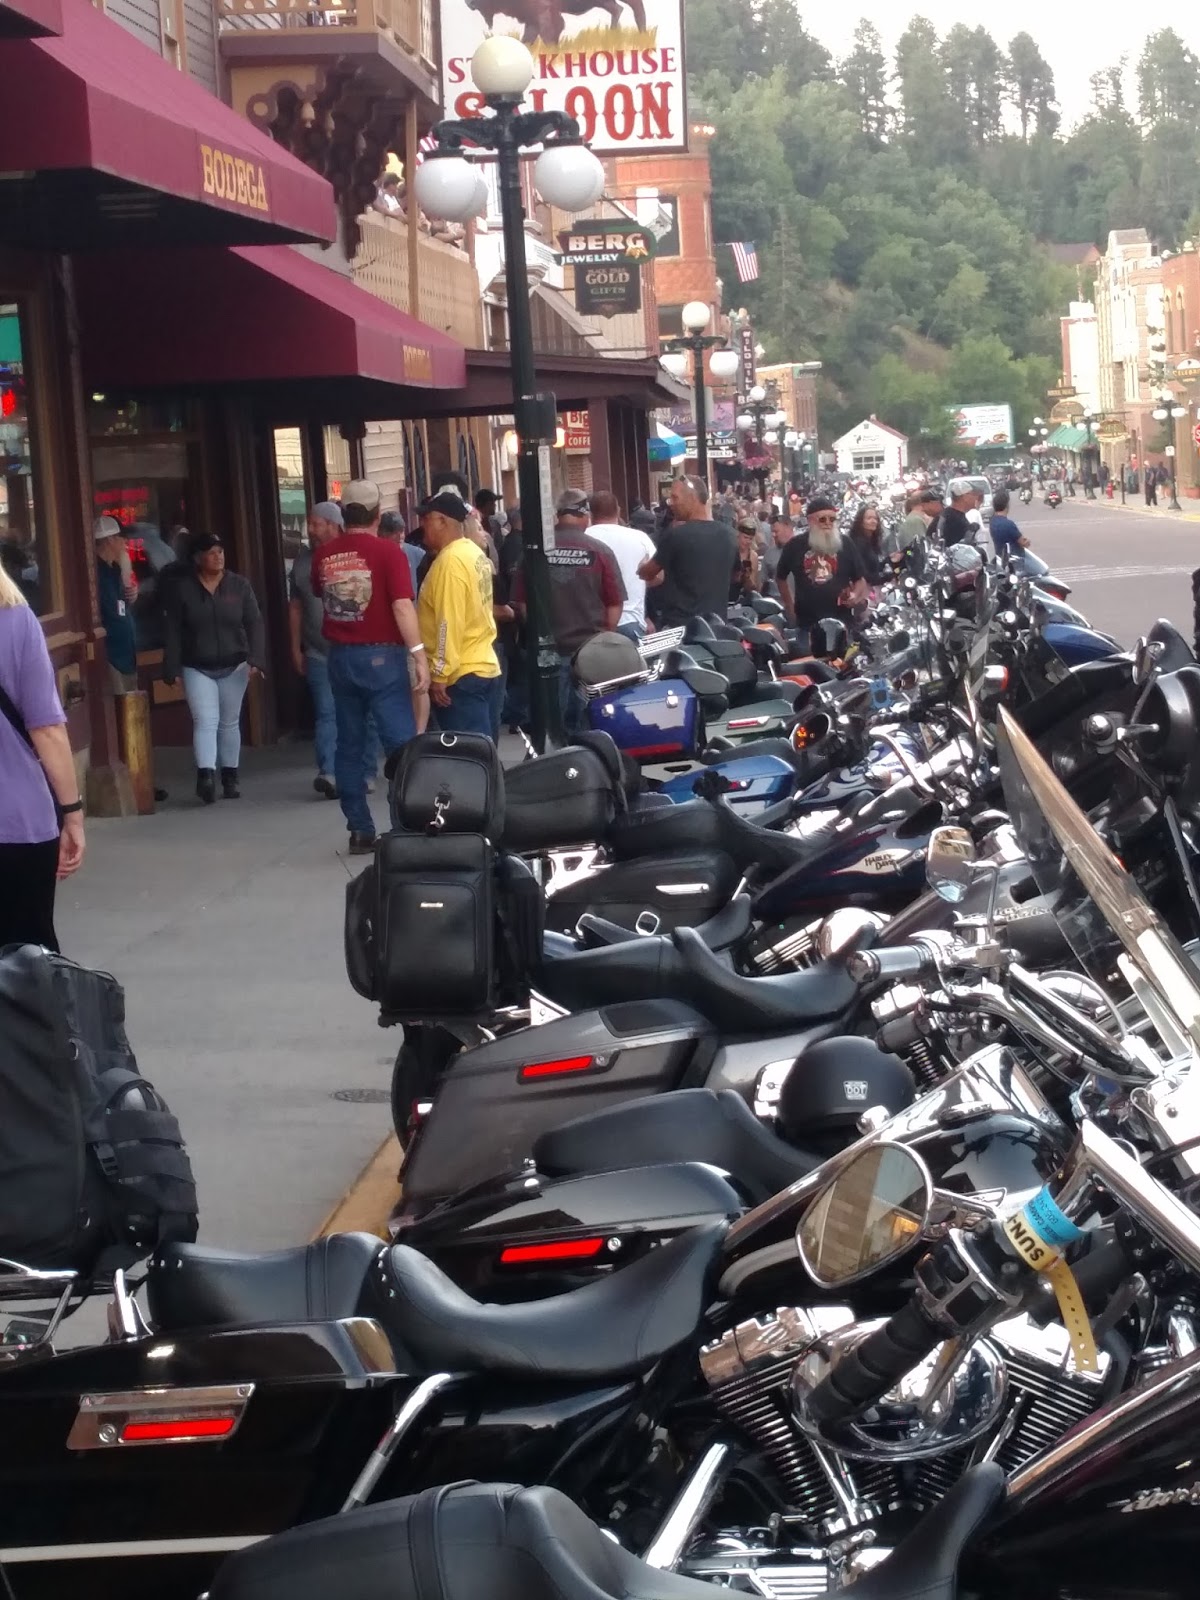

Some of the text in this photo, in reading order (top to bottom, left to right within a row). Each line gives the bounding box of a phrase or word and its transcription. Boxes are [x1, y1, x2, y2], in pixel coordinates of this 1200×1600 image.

[448, 47, 677, 84] SKHOUSE
[200, 144, 269, 211] BODEGA
[568, 233, 645, 251] BERG
[560, 253, 619, 265] JEWELRY
[585, 272, 630, 284] GOLD
[1006, 1213, 1045, 1262] SUN-
